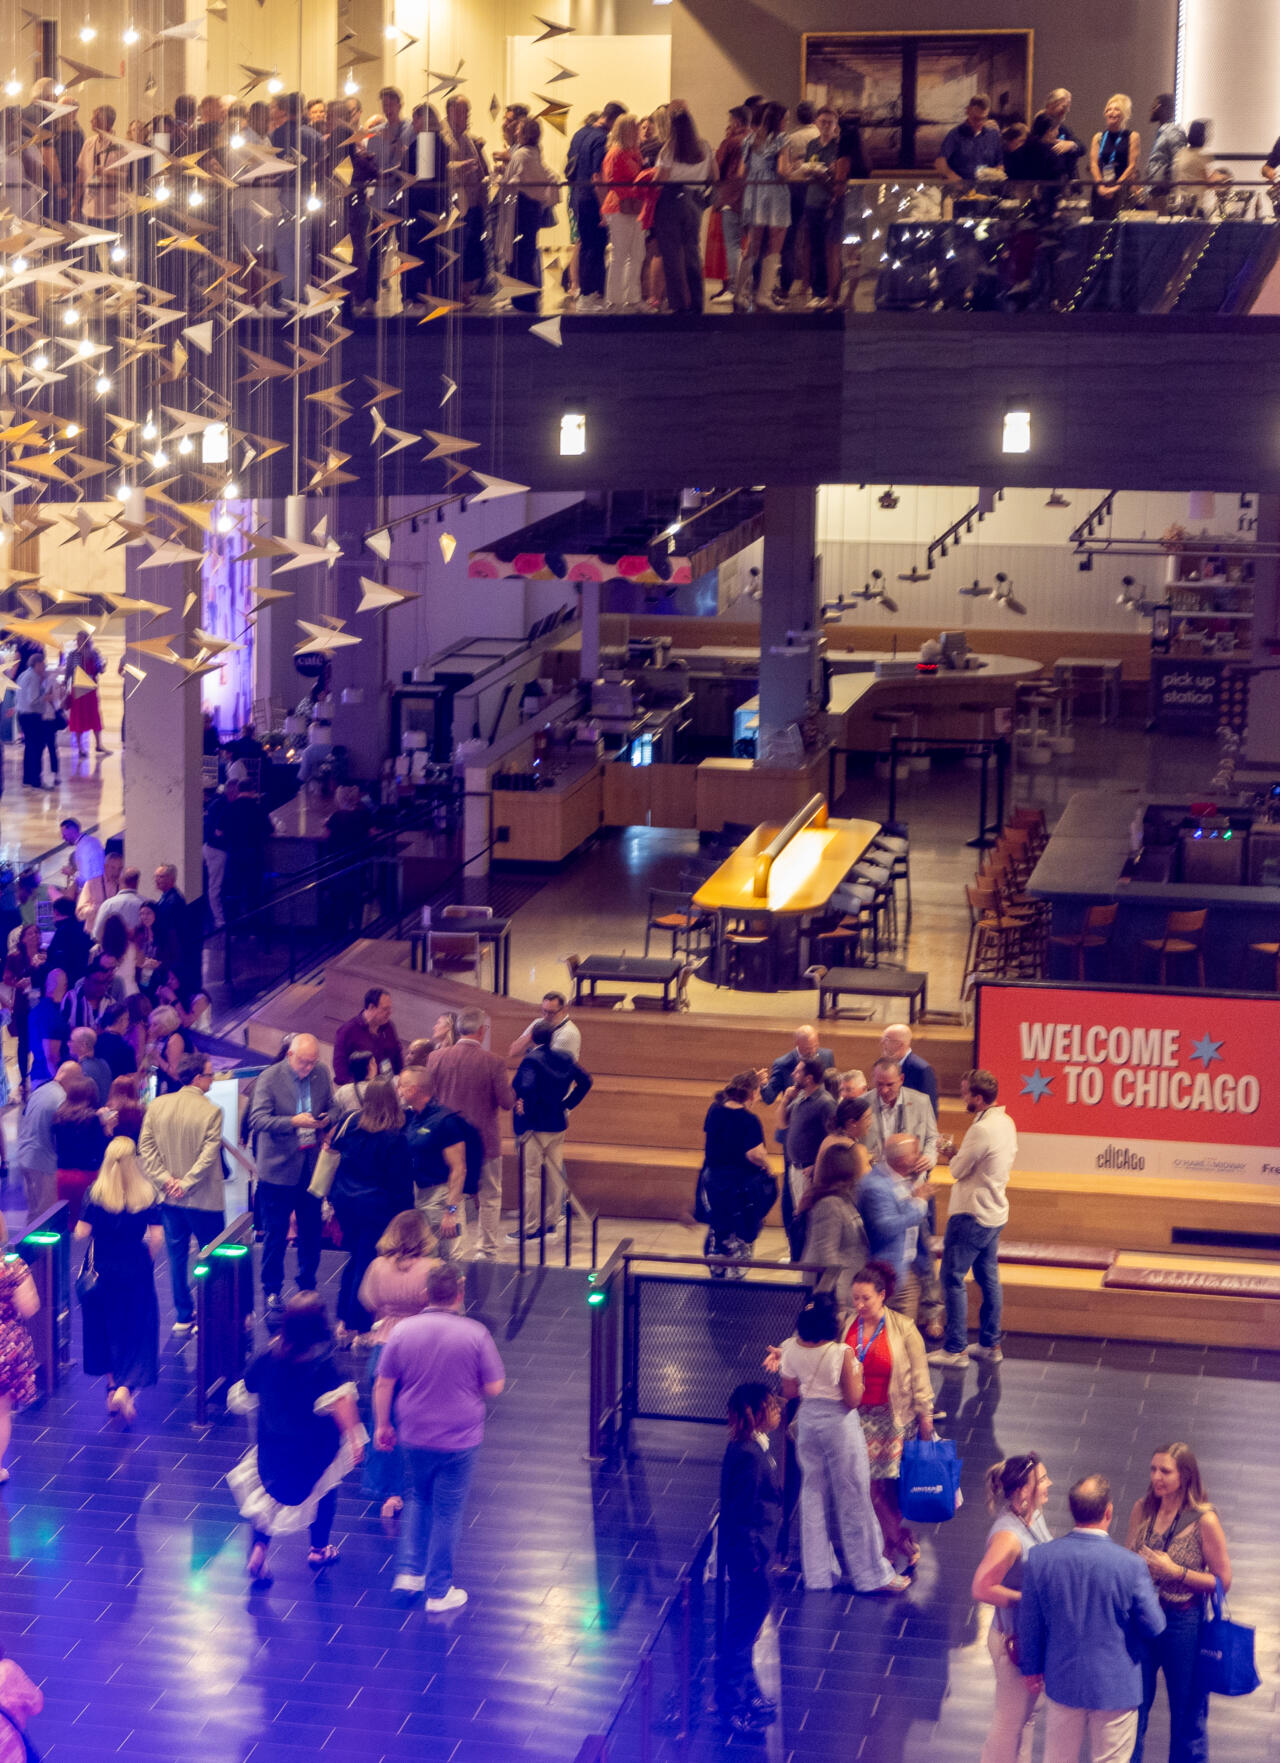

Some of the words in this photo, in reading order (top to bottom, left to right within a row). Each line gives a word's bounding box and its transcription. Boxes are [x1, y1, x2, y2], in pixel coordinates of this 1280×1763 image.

[1162, 672, 1194, 689] pick
[1195, 676, 1217, 691] up
[1163, 690, 1213, 704] station
[1021, 1022, 1180, 1067] WELCOME
[1064, 1065, 1104, 1105] TO
[1112, 1068, 1260, 1114] CHICAGO
